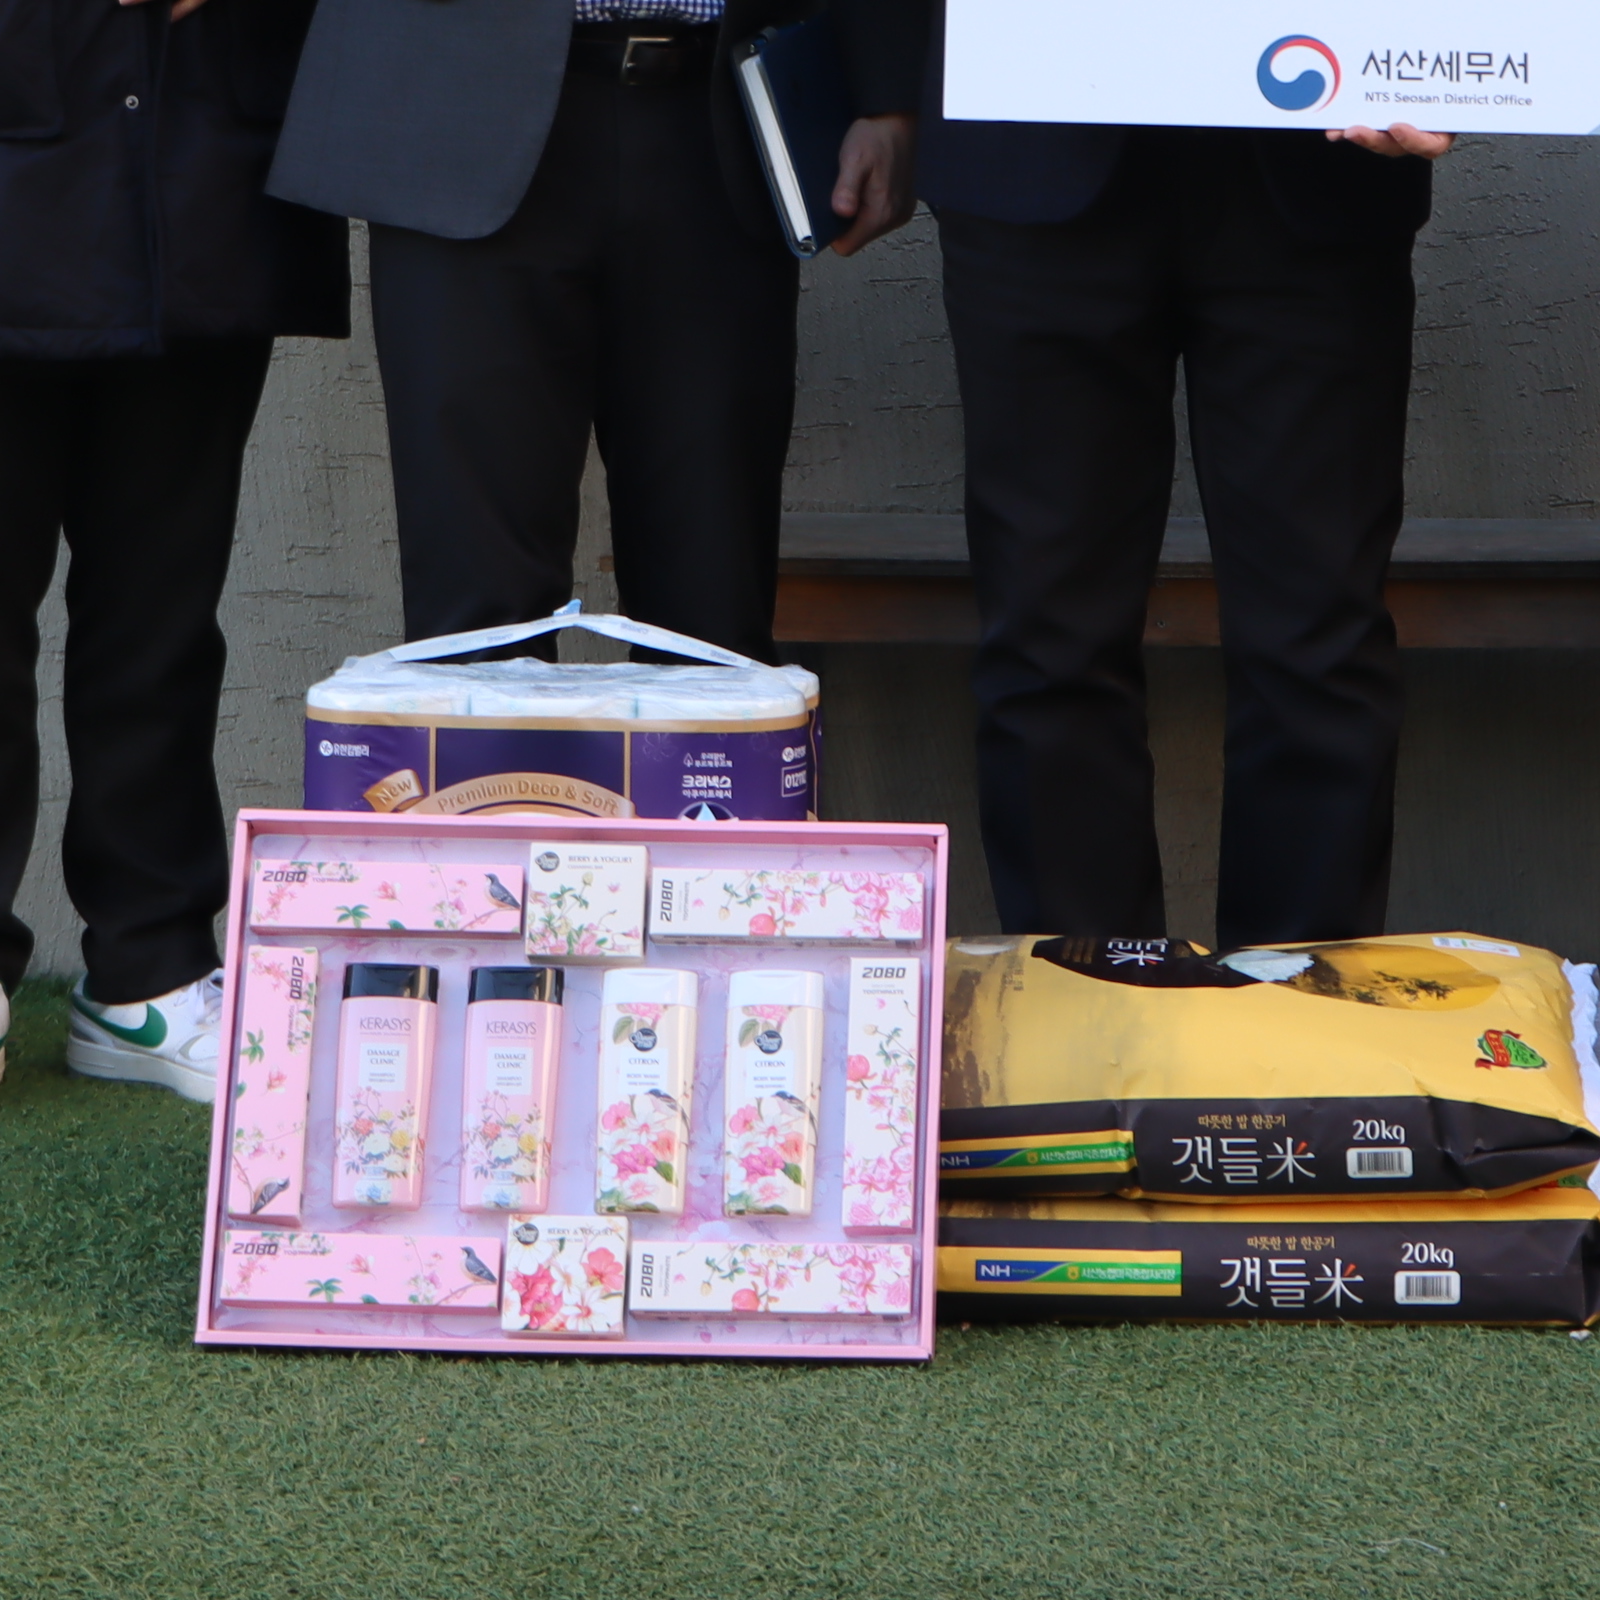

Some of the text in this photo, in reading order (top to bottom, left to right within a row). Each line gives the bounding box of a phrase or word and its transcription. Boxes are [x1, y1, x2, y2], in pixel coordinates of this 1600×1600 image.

[1362, 49, 1528, 84] 서산세무서
[1365, 91, 1532, 106] NTS Seosan District Office
[681, 774, 732, 788] 크리넥스
[375, 777, 413, 805] New
[437, 779, 620, 814] Premium Deco & Soft
[262, 870, 307, 883] 2080
[660, 879, 674, 923] 2080
[290, 956, 304, 1000] 2080
[862, 967, 907, 979] 2080
[360, 1017, 411, 1031] KERASYS
[486, 1021, 537, 1035] KERASYS
[367, 1049, 401, 1057] DAMAGE
[494, 1053, 527, 1061] DAMAGE
[370, 1058, 397, 1066] CLINIC
[497, 1061, 522, 1069] CLINIC
[628, 1058, 660, 1066] CITRON
[755, 1060, 786, 1068] CITRON
[1198, 1114, 1286, 1130] 따뜻한 밥 한공기
[1352, 1119, 1406, 1144] 20kg
[941, 1156, 970, 1166] NH
[232, 1242, 279, 1256] 2080
[1247, 1236, 1335, 1251] 따뜻한 밥 한공기
[1400, 1242, 1455, 1268] 20kg
[640, 1253, 655, 1299] 2080
[981, 1265, 1011, 1277] NH
